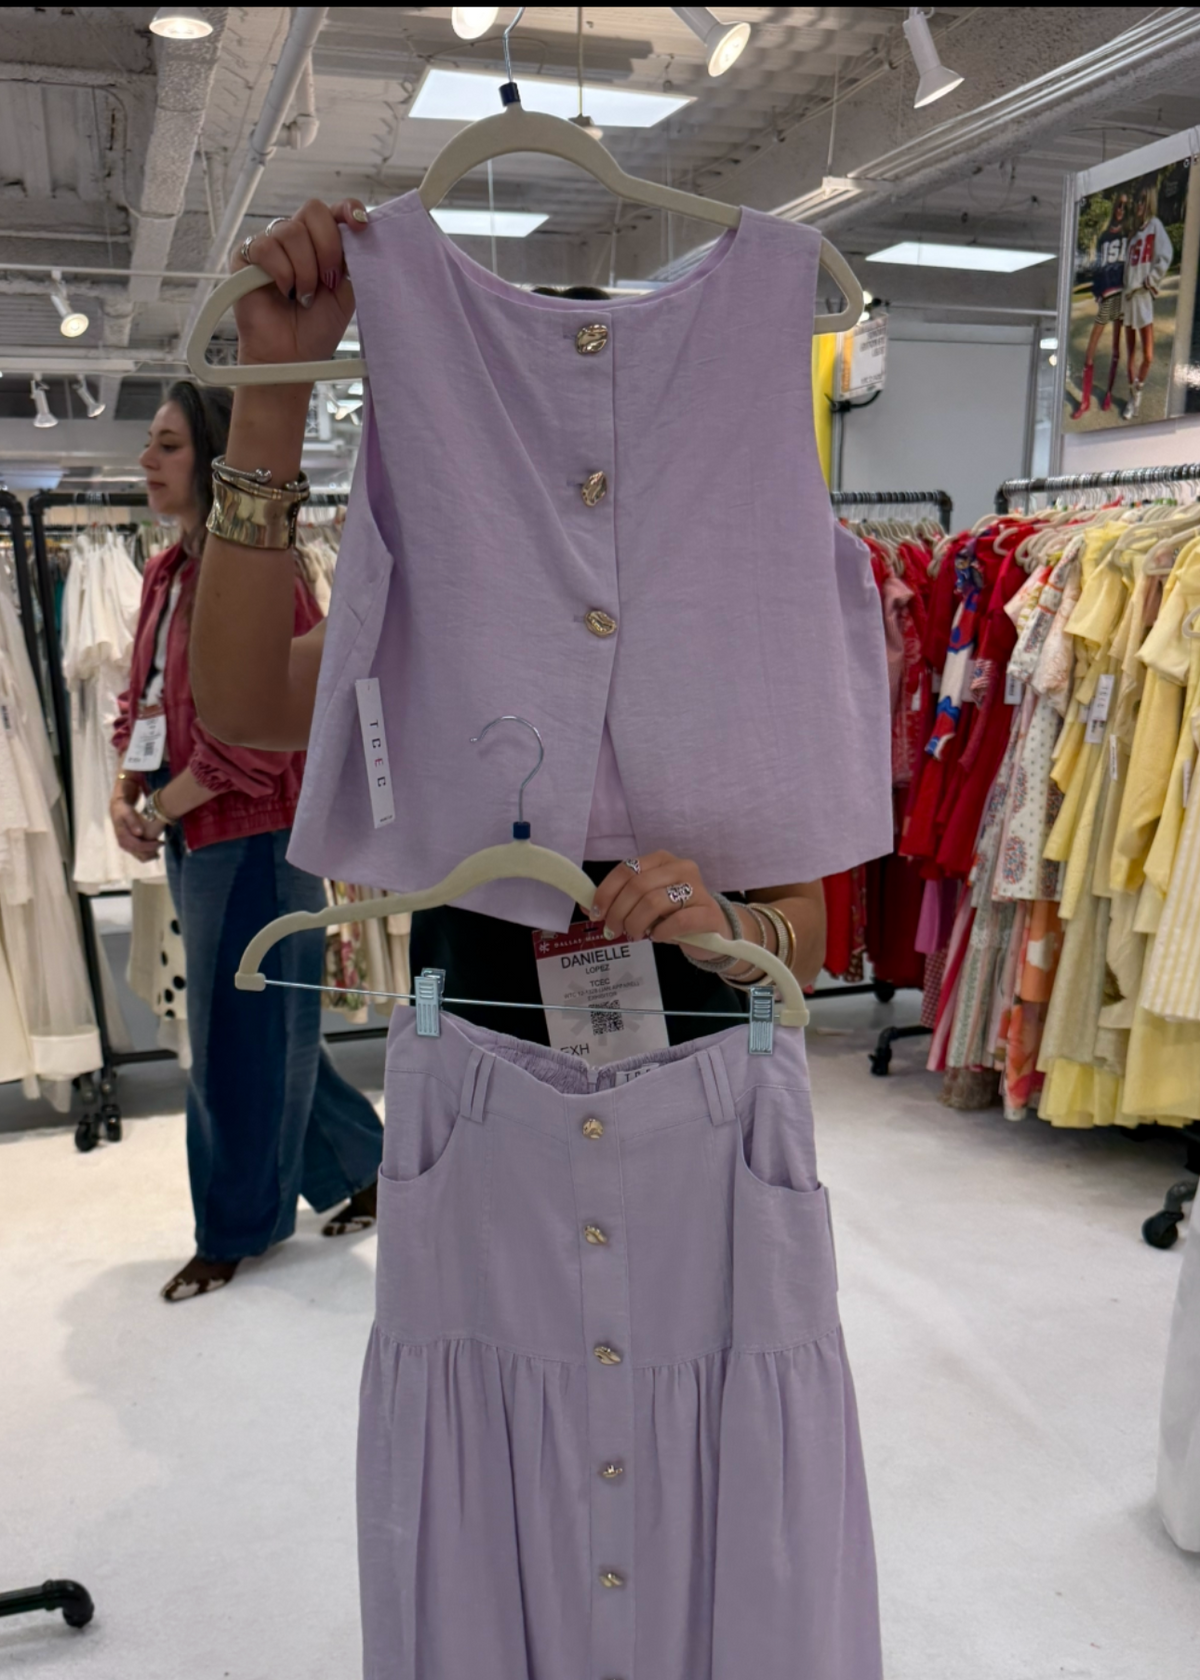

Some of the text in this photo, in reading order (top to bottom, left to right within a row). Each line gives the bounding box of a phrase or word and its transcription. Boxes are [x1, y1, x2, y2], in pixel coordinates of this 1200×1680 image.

[369, 718, 387, 788] TCEC
[554, 934, 604, 948] DALLAS MARK
[561, 945, 631, 969] DANIELLE
[585, 964, 610, 975] LOPEZ
[589, 978, 611, 987] TCEC
